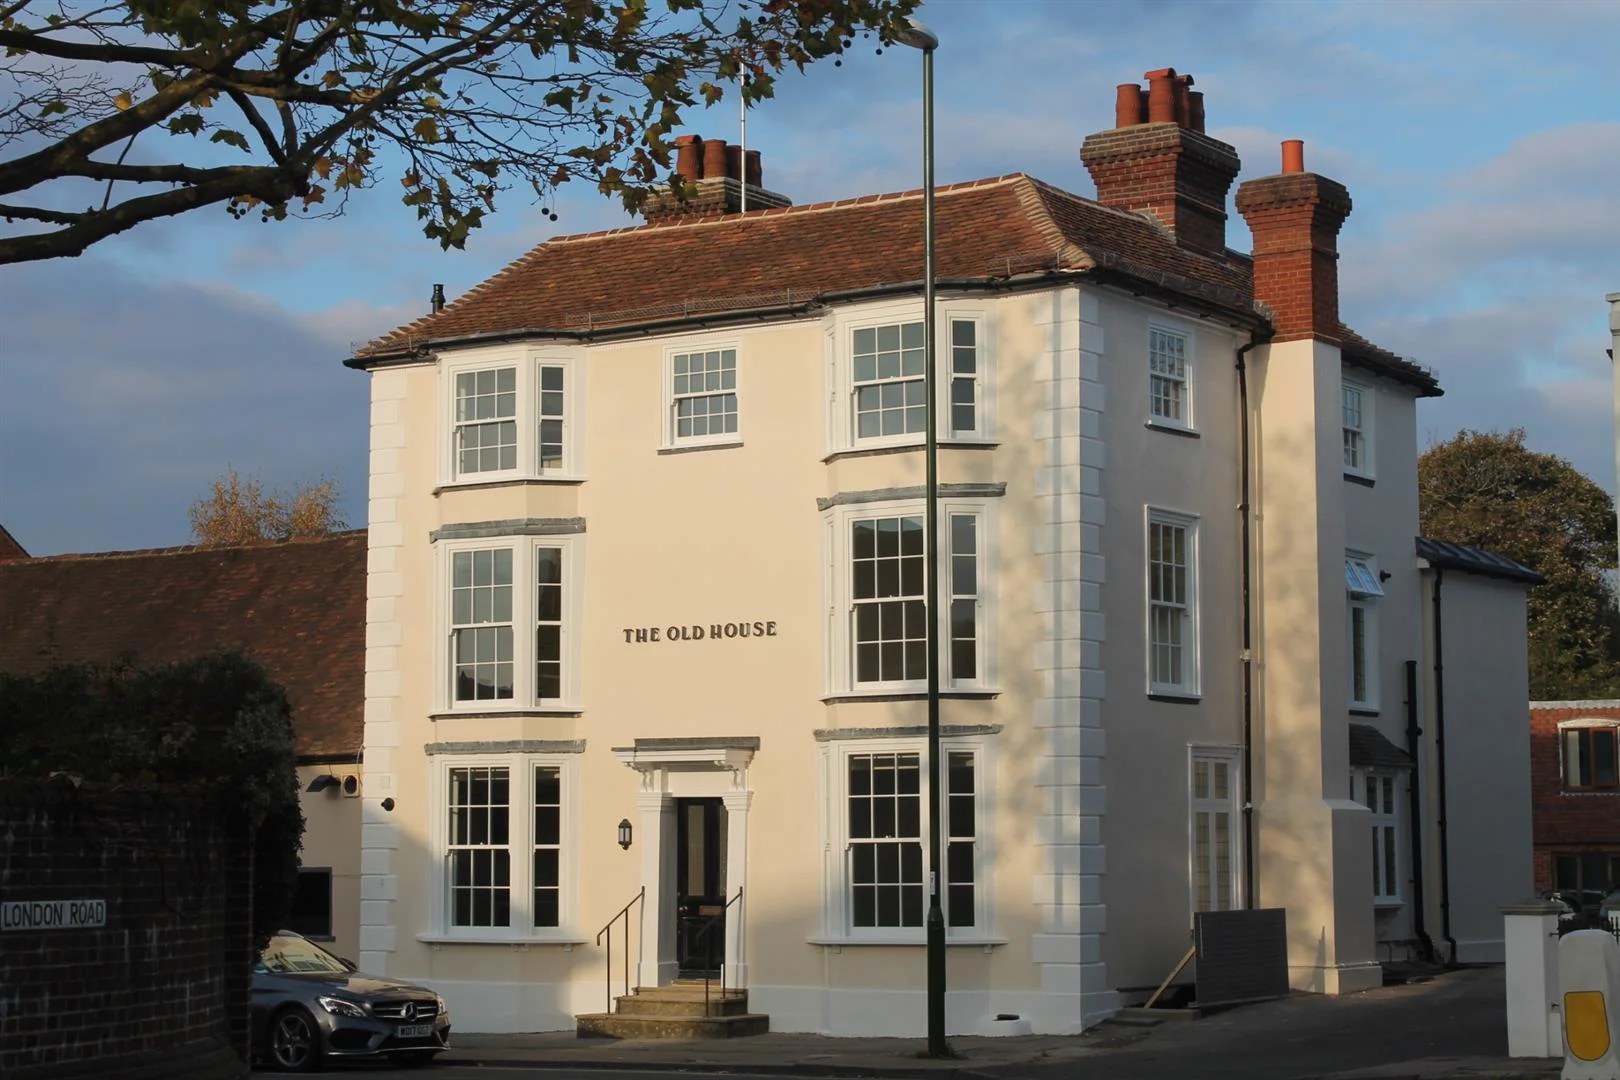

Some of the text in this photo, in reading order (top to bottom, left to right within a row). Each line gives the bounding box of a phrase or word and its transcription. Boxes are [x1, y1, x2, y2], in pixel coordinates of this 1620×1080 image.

[623, 621, 777, 643] THE OLD HOUSE
[4, 902, 104, 927] LONDON ROAD
